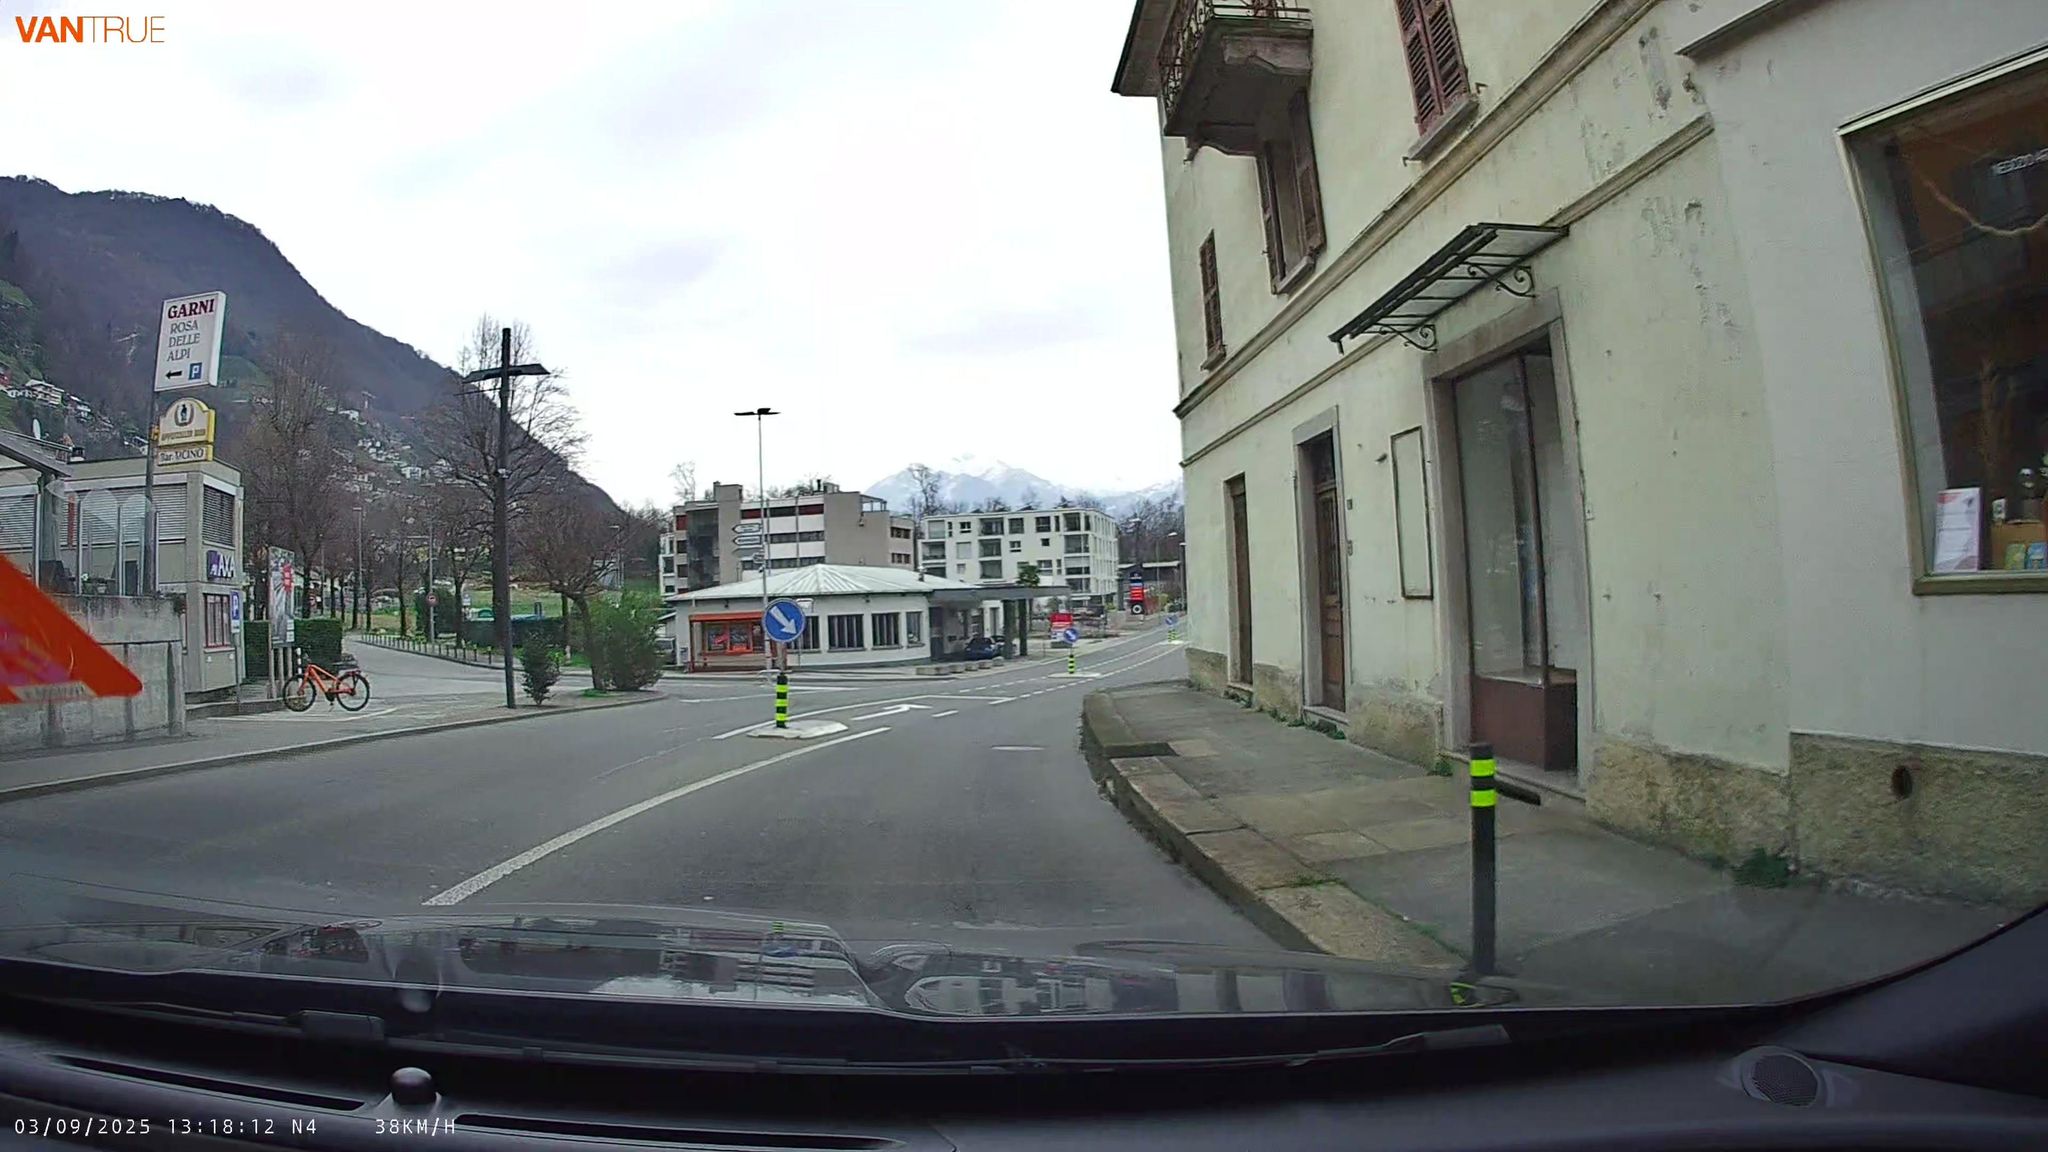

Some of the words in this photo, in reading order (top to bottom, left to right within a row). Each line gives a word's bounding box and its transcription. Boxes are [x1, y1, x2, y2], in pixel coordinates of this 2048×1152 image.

[168, 299, 215, 319] GARNI
[170, 320, 199, 334] ROSA
[168, 333, 200, 348] DELLE
[167, 348, 191, 362] ALPI
[218, 553, 236, 578] AXA
